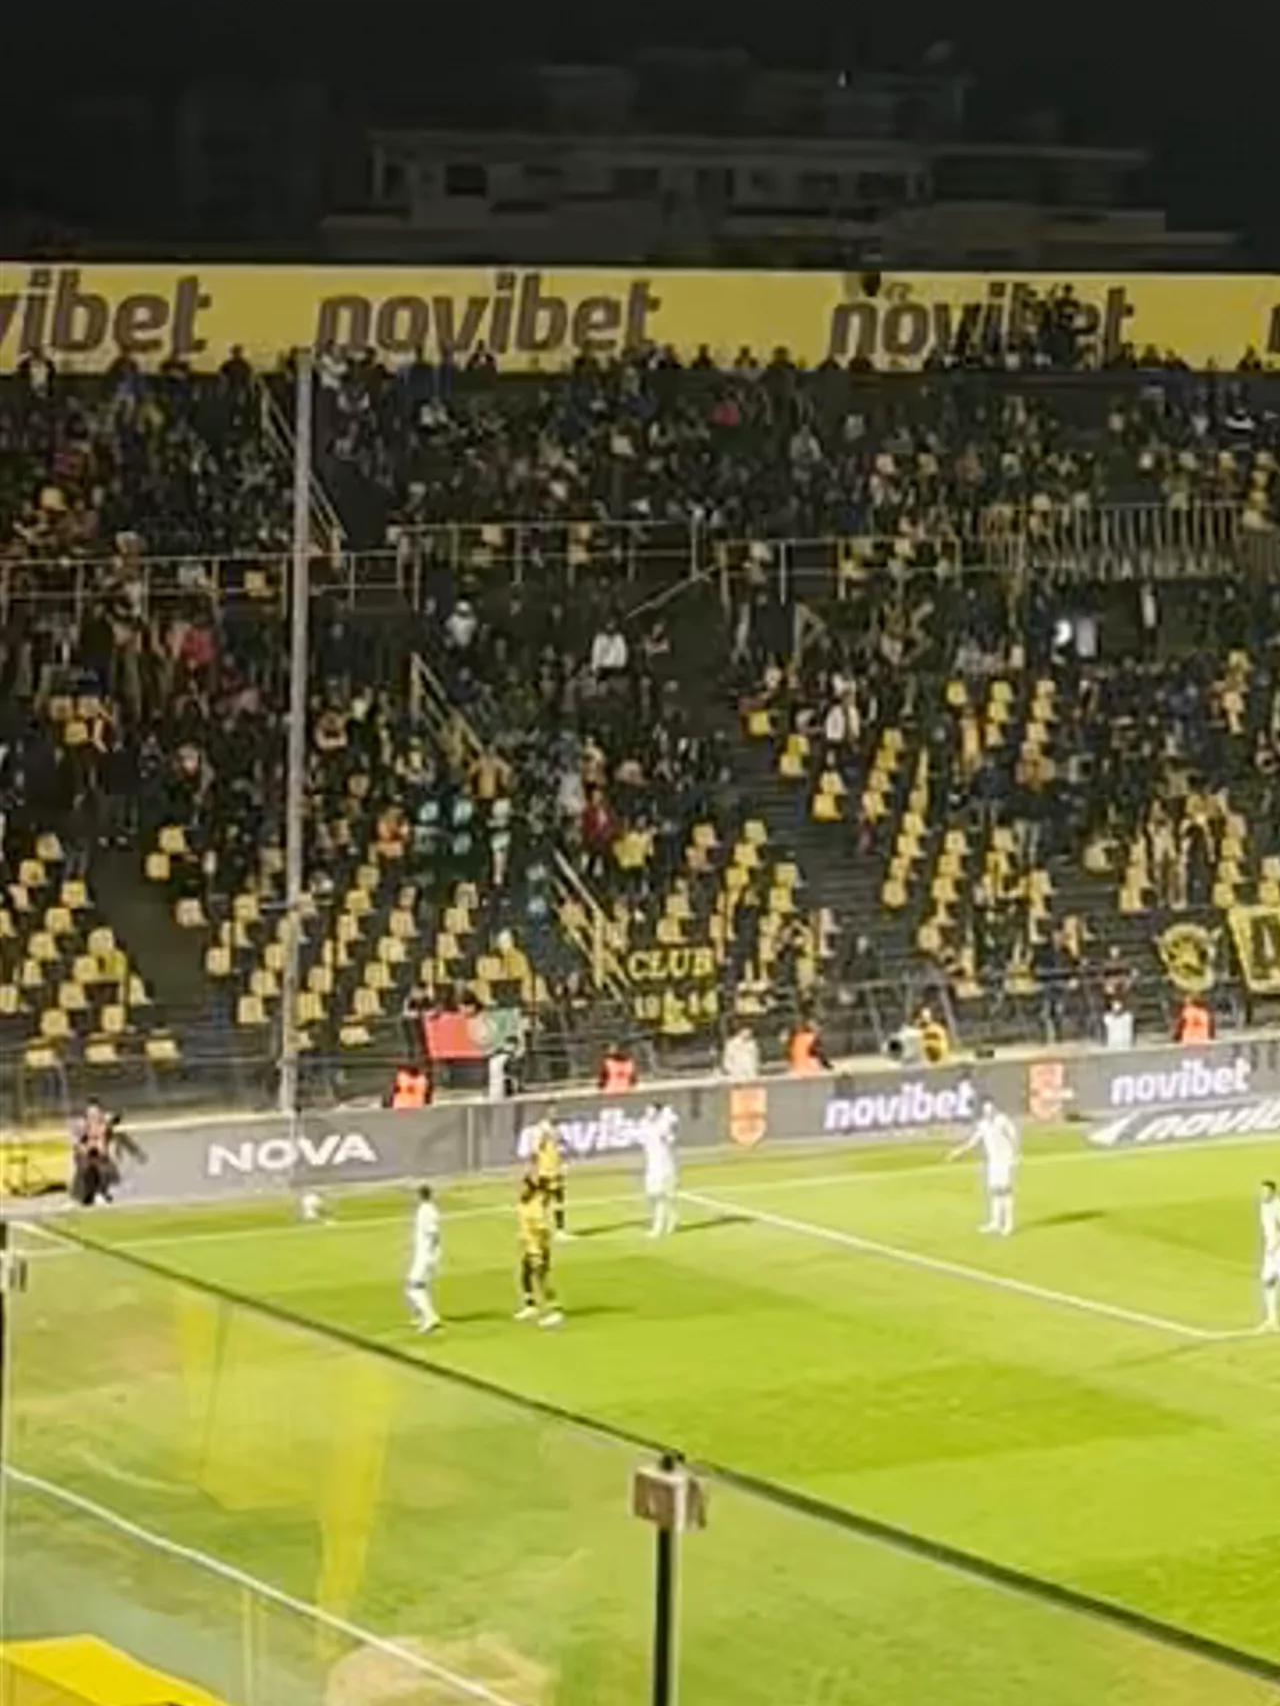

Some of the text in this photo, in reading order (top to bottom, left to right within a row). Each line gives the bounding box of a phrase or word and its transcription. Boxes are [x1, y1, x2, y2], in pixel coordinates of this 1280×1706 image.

[316, 270, 662, 354] novibet
[208, 1133, 378, 1175] NOVA
[825, 1080, 975, 1132] novibet
[1111, 1058, 1250, 1105] novibet
